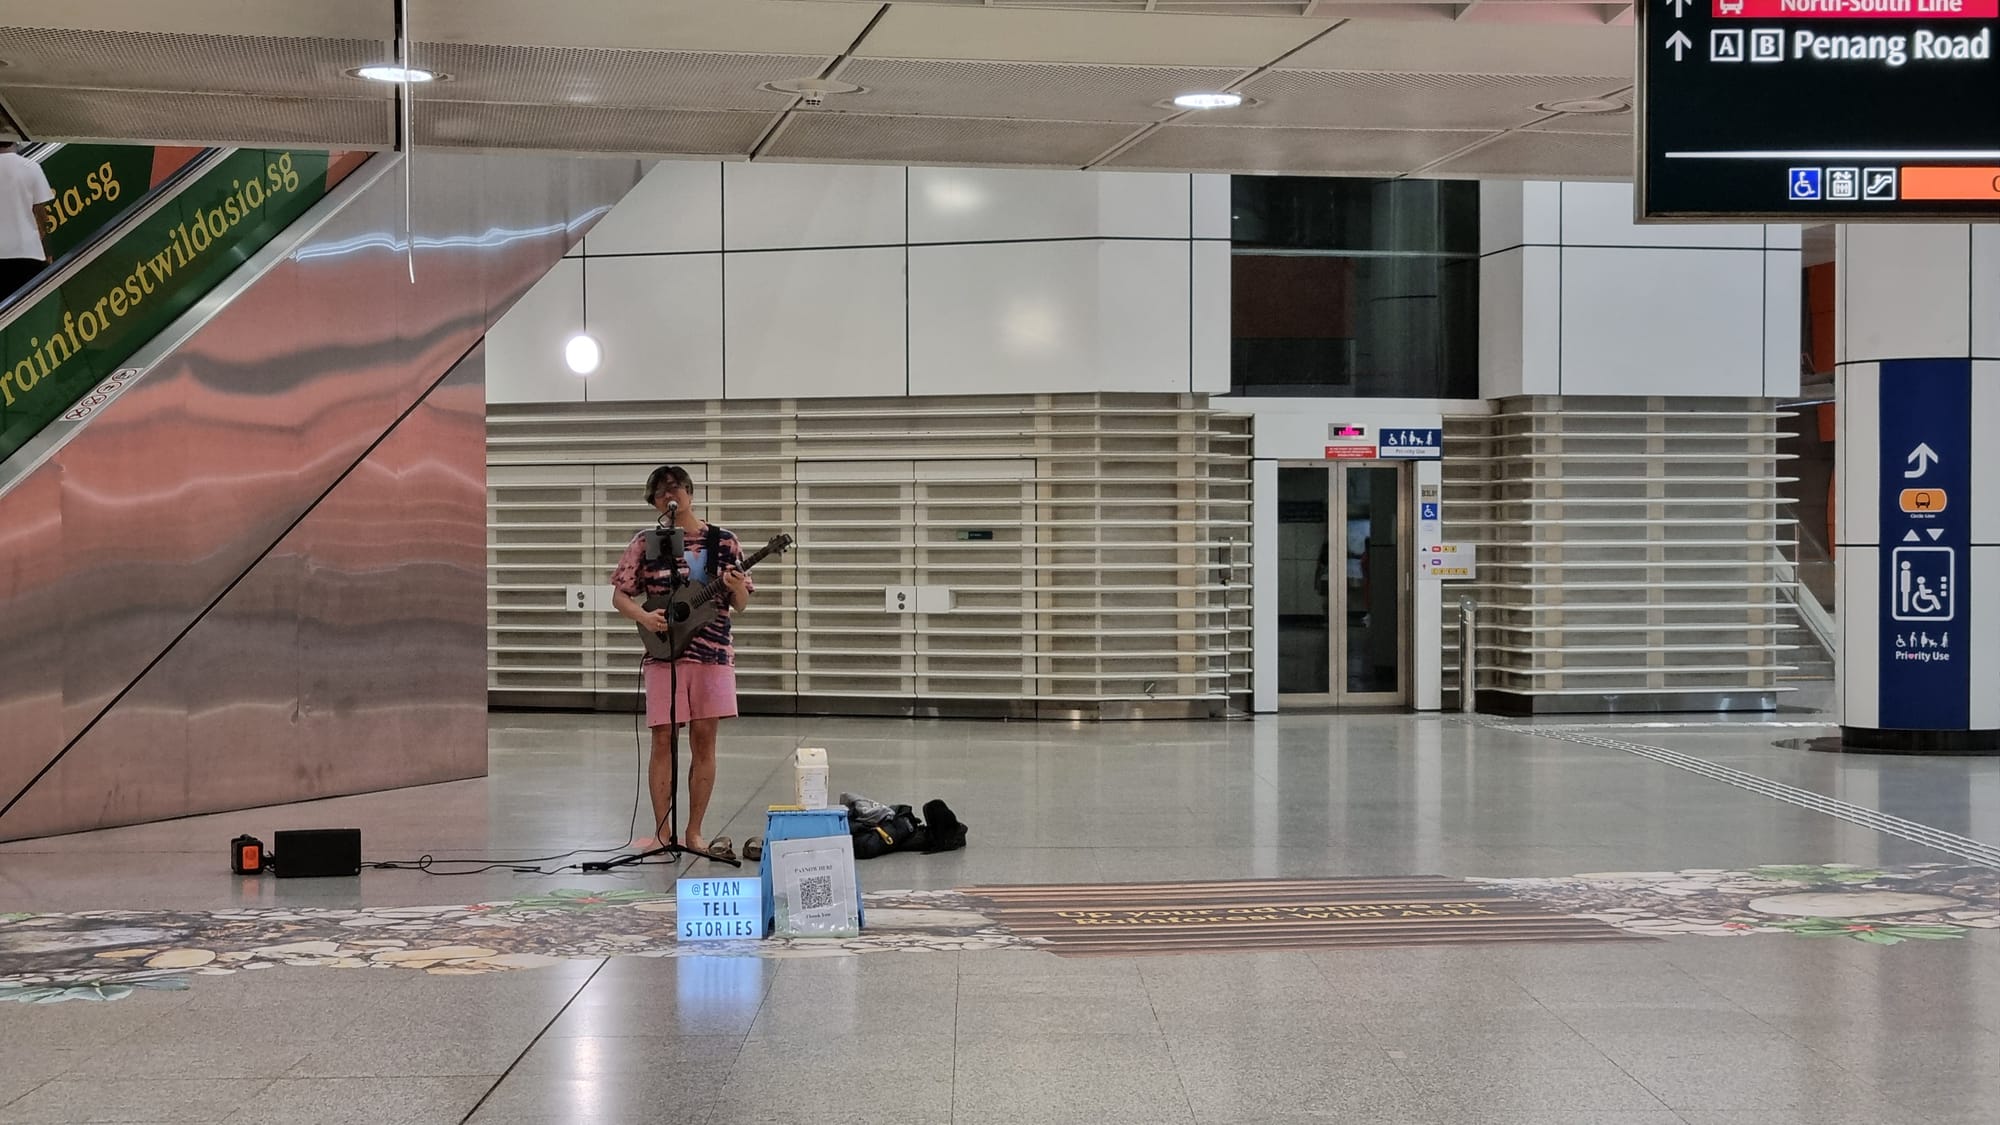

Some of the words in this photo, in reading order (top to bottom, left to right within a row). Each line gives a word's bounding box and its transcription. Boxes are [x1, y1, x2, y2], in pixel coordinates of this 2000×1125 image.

[1781, 0, 1911, 12] North-South
[1917, 0, 1962, 12] Line
[1719, 35, 1735, 56] A
[1760, 35, 1776, 56] B
[1794, 29, 1907, 66] Penang
[1913, 27, 1990, 60] Road
[0, 151, 300, 406] rainforestwildasia.sg
[1895, 650, 1931, 662] Priority
[1932, 651, 1950, 661] Use
[691, 881, 741, 897] @EVAN
[703, 902, 740, 917] TELL
[1126, 909, 1214, 918] your
[1227, 904, 1431, 914] adventure
[1072, 914, 1284, 925] Rainforest
[1289, 911, 1385, 919] Wild
[685, 921, 753, 937] STORIES
